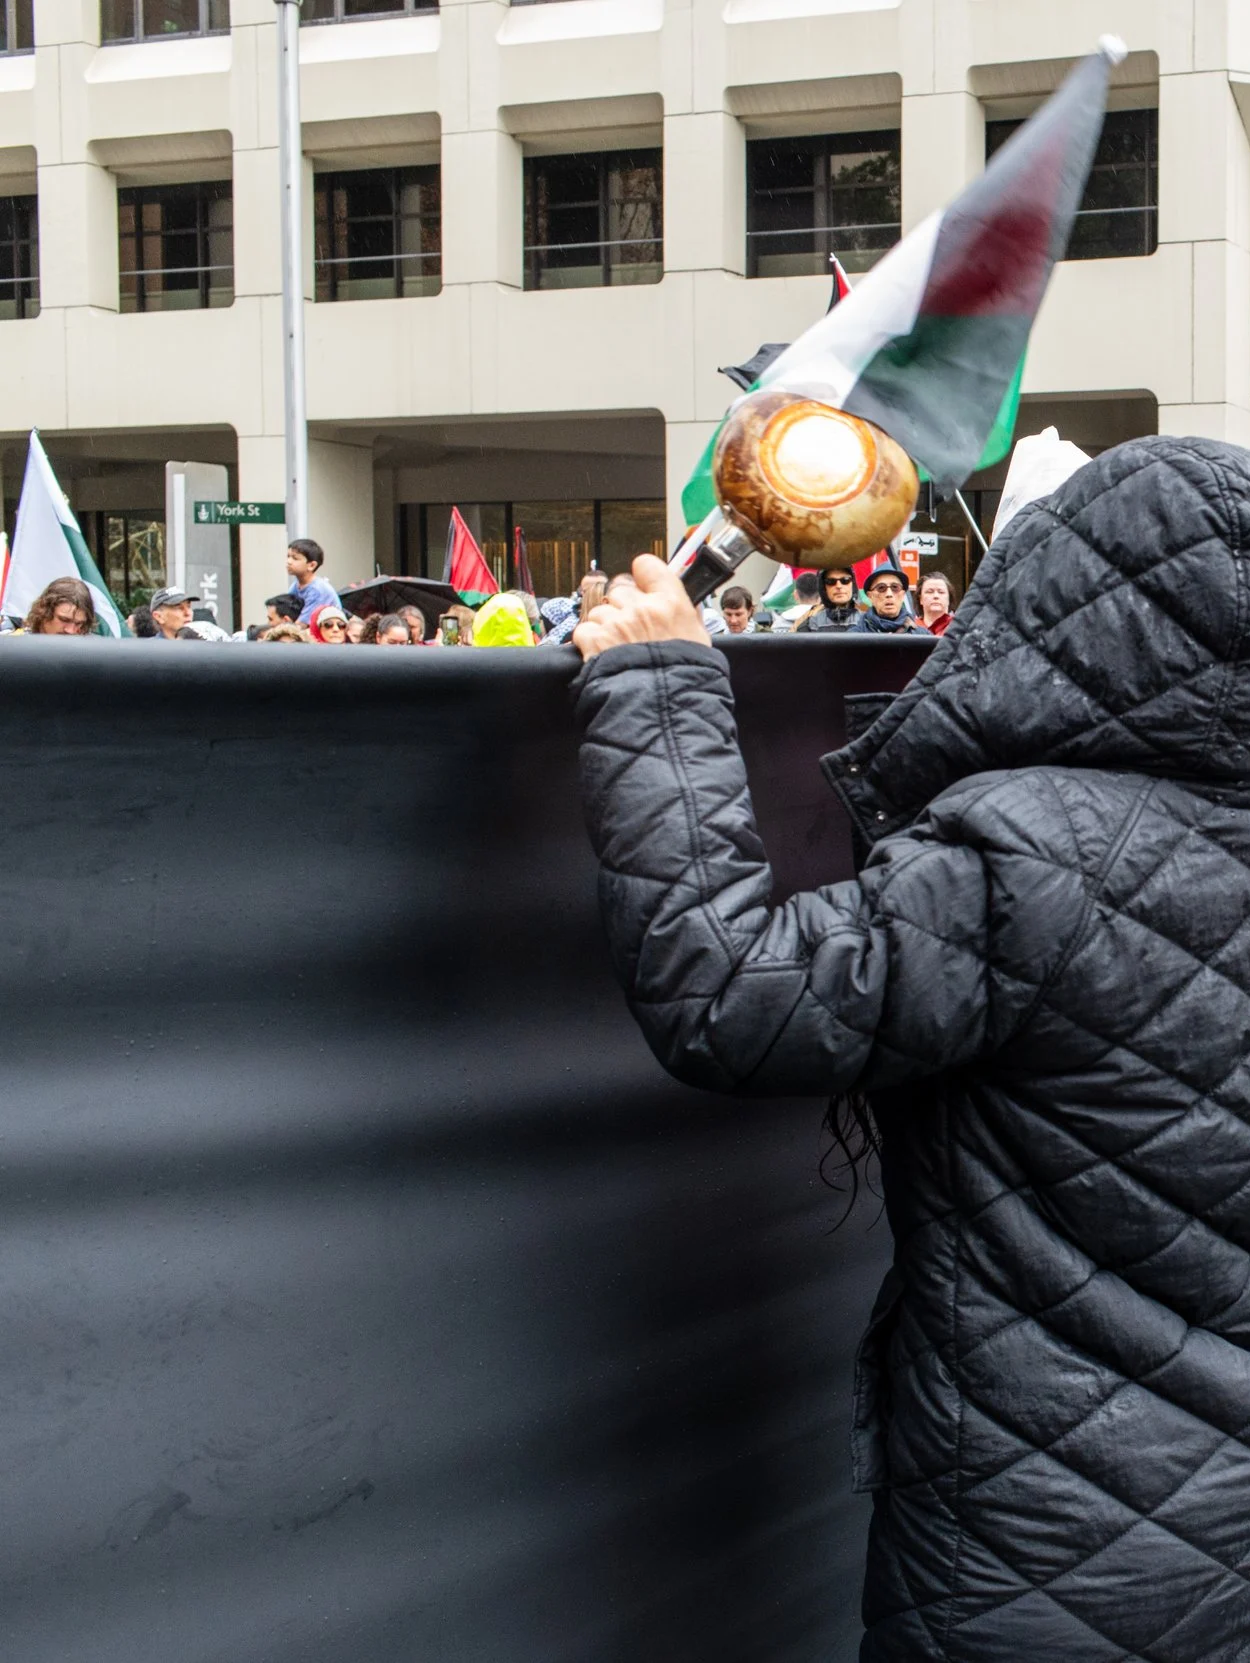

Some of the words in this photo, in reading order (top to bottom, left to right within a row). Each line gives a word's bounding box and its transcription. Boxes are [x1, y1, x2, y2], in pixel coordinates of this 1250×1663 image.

[217, 504, 245, 517] York
[247, 505, 260, 517] St
[200, 572, 218, 617] ork
